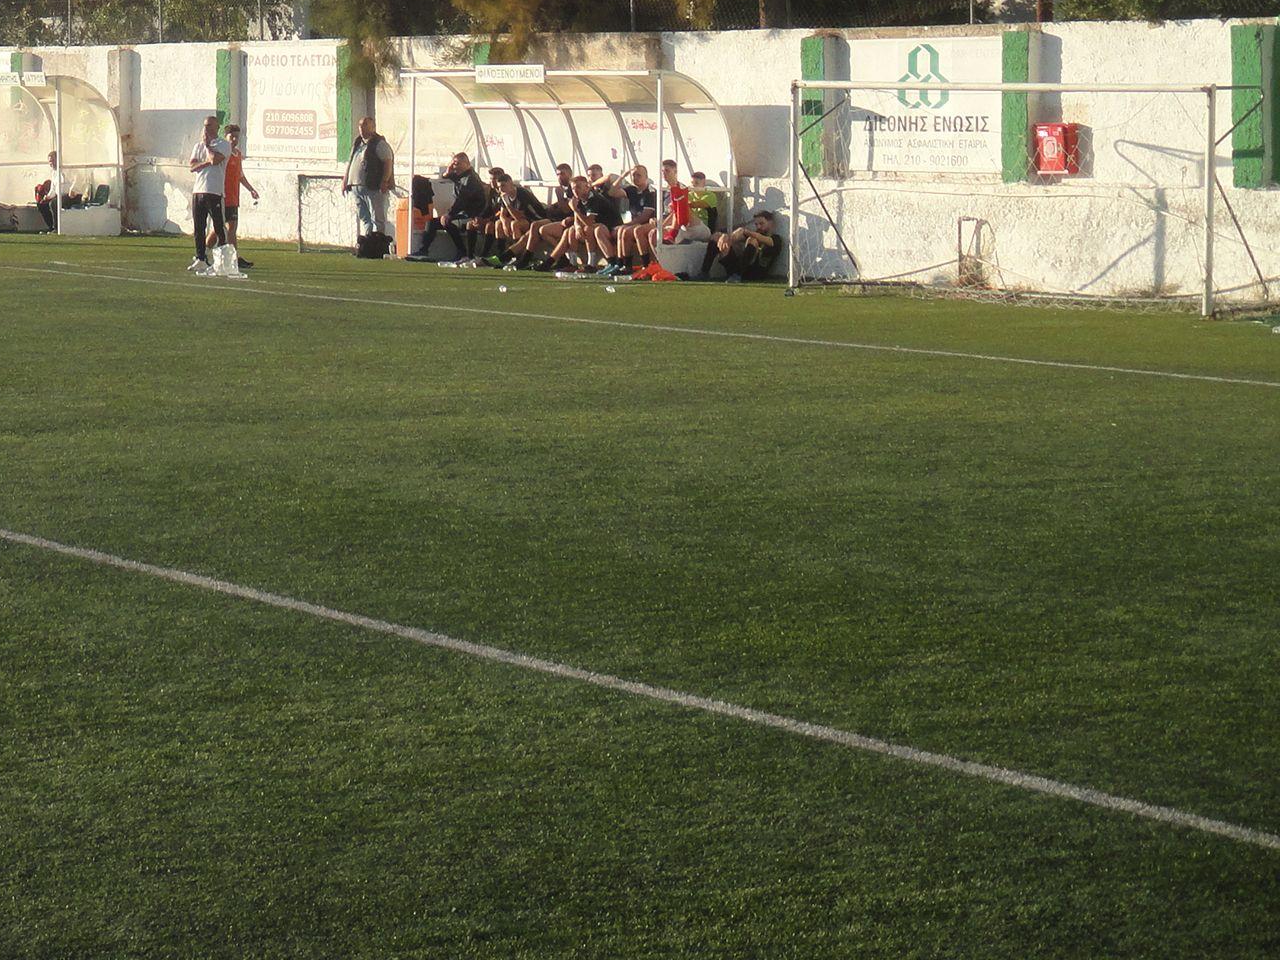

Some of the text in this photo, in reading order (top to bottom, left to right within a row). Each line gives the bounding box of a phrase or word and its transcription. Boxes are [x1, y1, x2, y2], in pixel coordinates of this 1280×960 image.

[242, 53, 288, 67] ΓΡΑΦΕΙΟ
[478, 68, 542, 78] ΦΙΛΟΞΕΝΟΥΜΕΝΟΙ
[265, 125, 314, 136] 6977062455
[863, 115, 990, 133] ΔΙΕΘΝΗΣ ΕΝΩΣΙΣ
[904, 154, 921, 165] 210
[929, 155, 969, 167] 9021600
